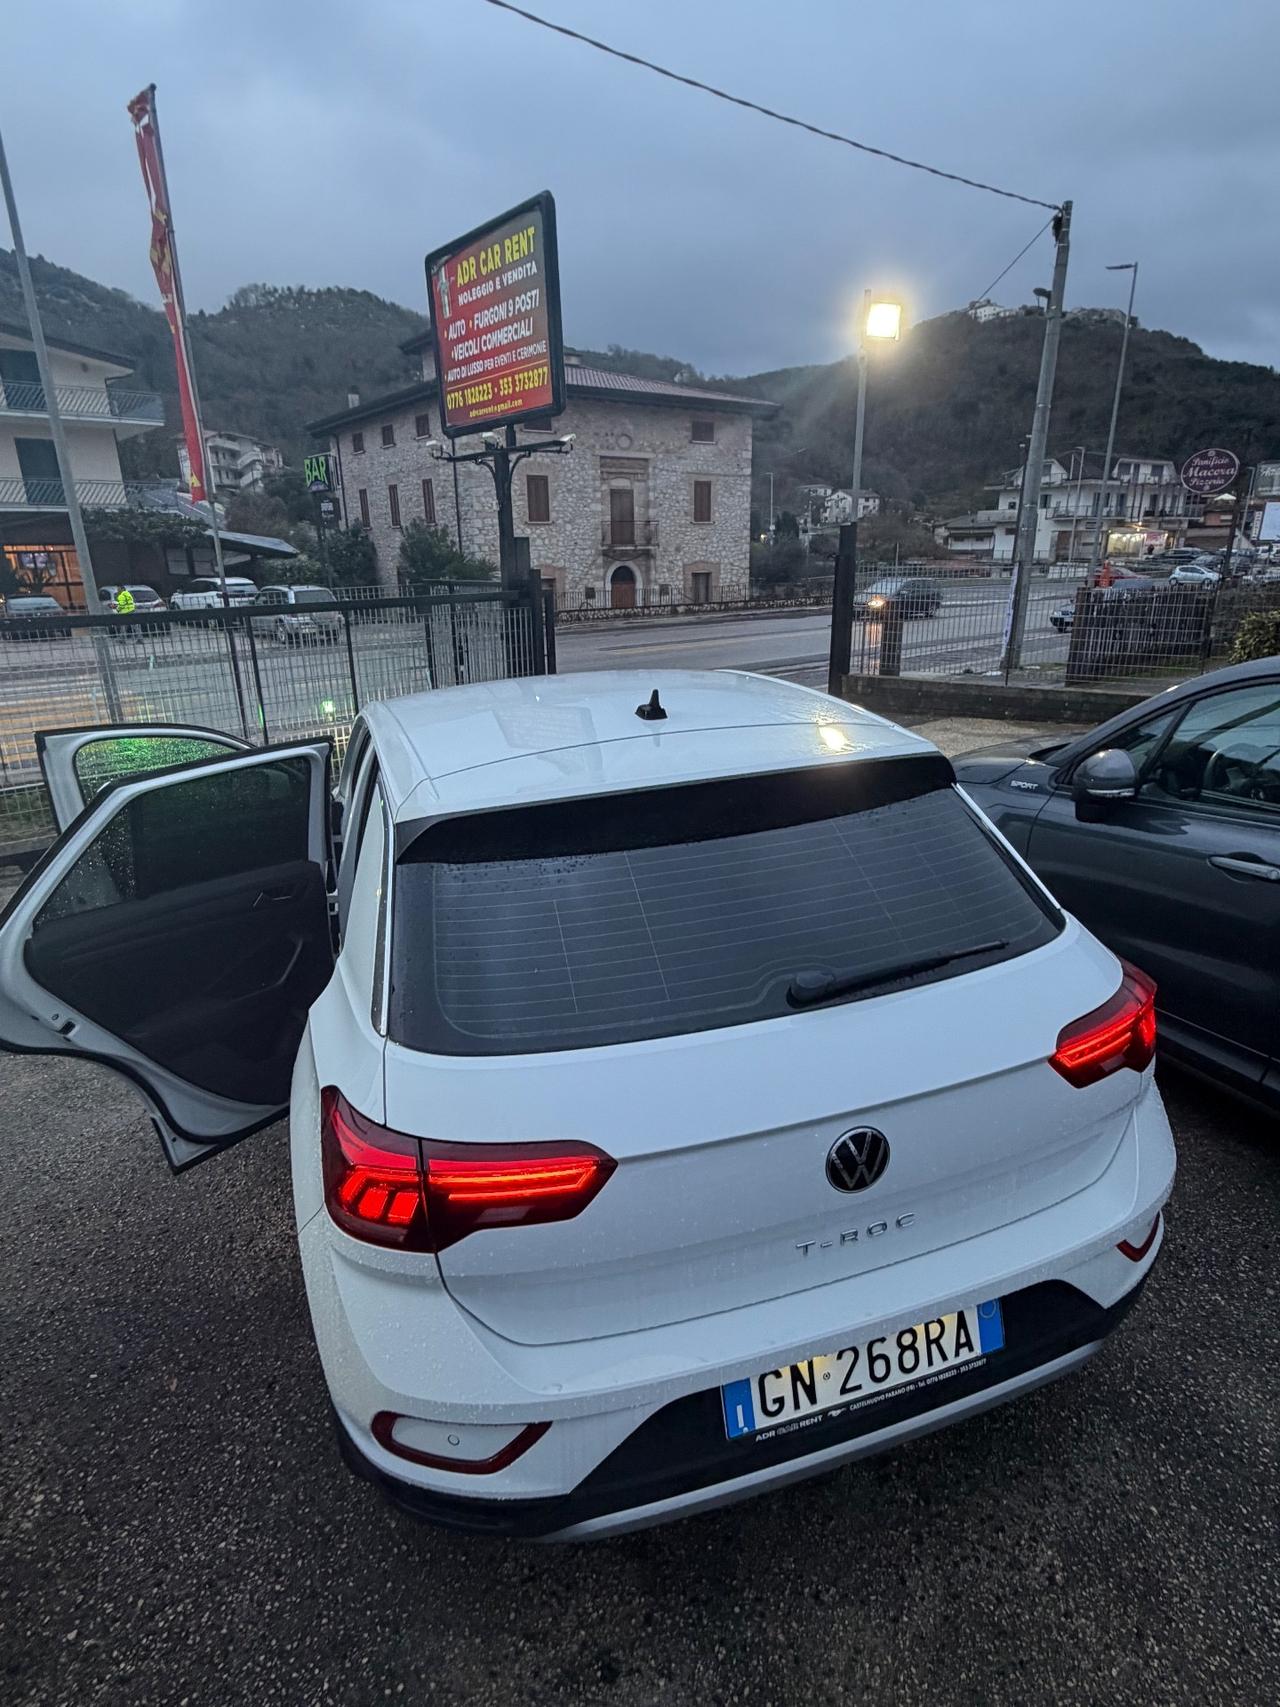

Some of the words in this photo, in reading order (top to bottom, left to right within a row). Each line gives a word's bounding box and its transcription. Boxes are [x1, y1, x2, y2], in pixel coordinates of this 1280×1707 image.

[457, 256, 477, 288] ADR
[479, 243, 502, 276] CAR
[504, 226, 535, 265] RENT
[458, 280, 494, 306] NOLEGGIO
[495, 277, 501, 290] E
[502, 260, 538, 286] VENDITA
[448, 319, 466, 341] AUTO
[473, 301, 507, 331] FURGONI
[508, 298, 513, 317] 9
[515, 288, 540, 314] POSTI
[448, 368, 461, 382] AUTO
[461, 365, 467, 378] DI
[467, 359, 484, 377] LUSSO
[484, 356, 494, 371] PER
[494, 351, 512, 367] EVENTI
[516, 340, 547, 360] CERIMONIE
[453, 336, 480, 361] VEICOLI
[481, 317, 533, 352] COMMERCIALI
[447, 390, 464, 411] 0776
[499, 376, 513, 397] 353
[515, 366, 548, 393] 3732877
[304, 456, 328, 488] BAR
[1011, 780, 1038, 790] SPORT
[796, 1212, 915, 1257] T-ROC
[758, 1359, 818, 1418] GN
[837, 1310, 975, 1396] 268RA
[755, 1430, 776, 1443] ADR
[799, 1415, 823, 1428] RENT
